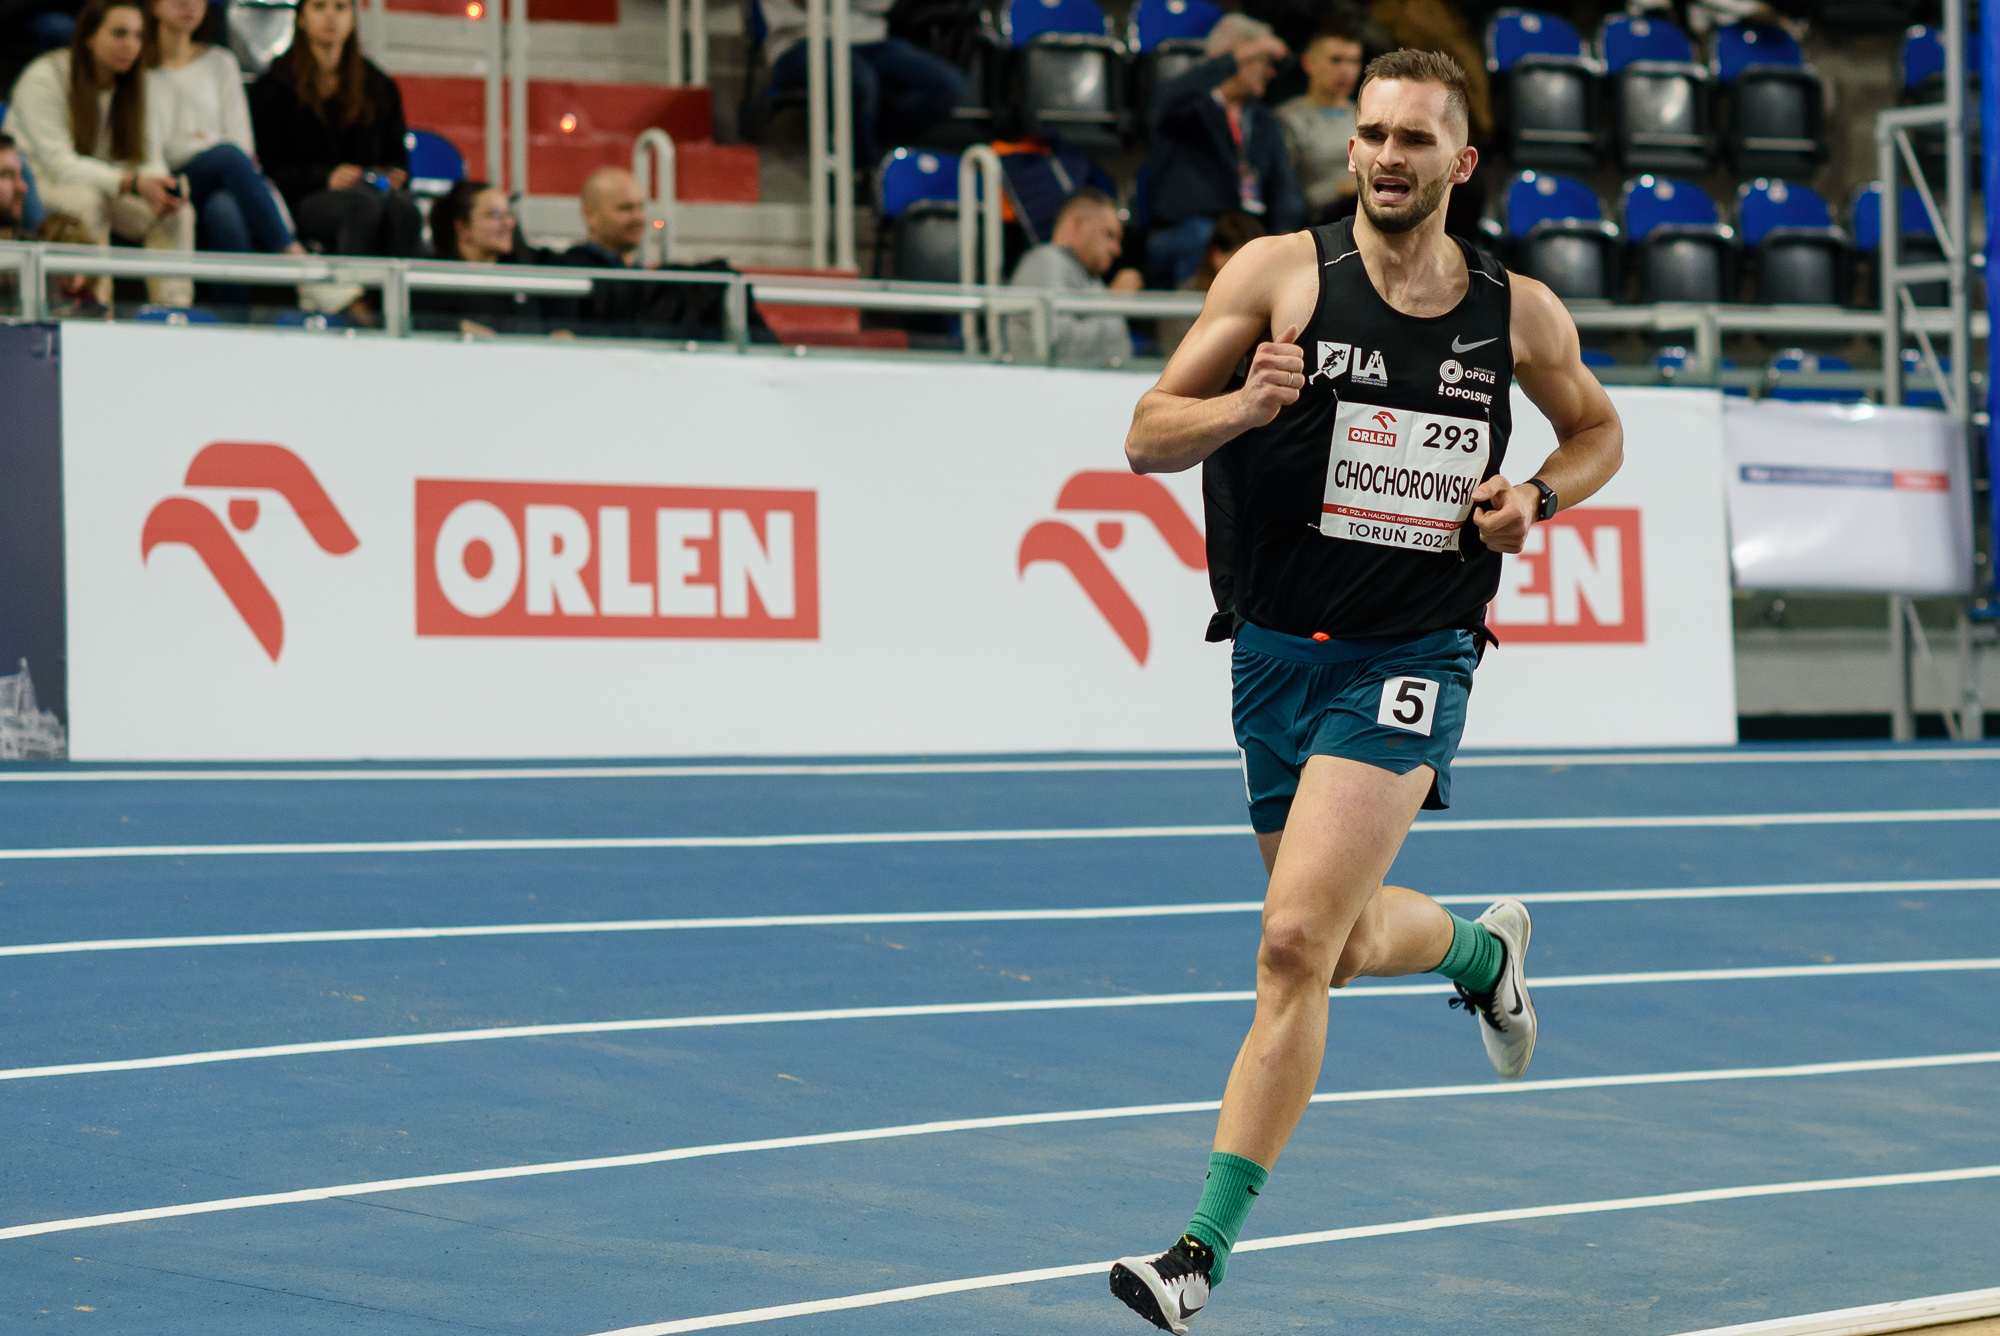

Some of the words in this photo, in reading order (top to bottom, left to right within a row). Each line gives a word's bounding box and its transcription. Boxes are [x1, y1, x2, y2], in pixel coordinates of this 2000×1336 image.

[1464, 370, 1496, 384] OPOLE
[1445, 386, 1492, 405] OPOLSKIE
[1350, 430, 1395, 446] ORLEN
[1422, 422, 1479, 453] 293
[1335, 459, 1477, 505] CHOCHOROWSKI
[1349, 509, 1367, 518] PZLA
[1367, 512, 1396, 522] HALOWE
[1396, 516, 1444, 528] MISTRZOSTWA
[1348, 521, 1407, 543] TORUŃ
[434, 499, 797, 619] ORLEN
[1392, 680, 1427, 725] 5
